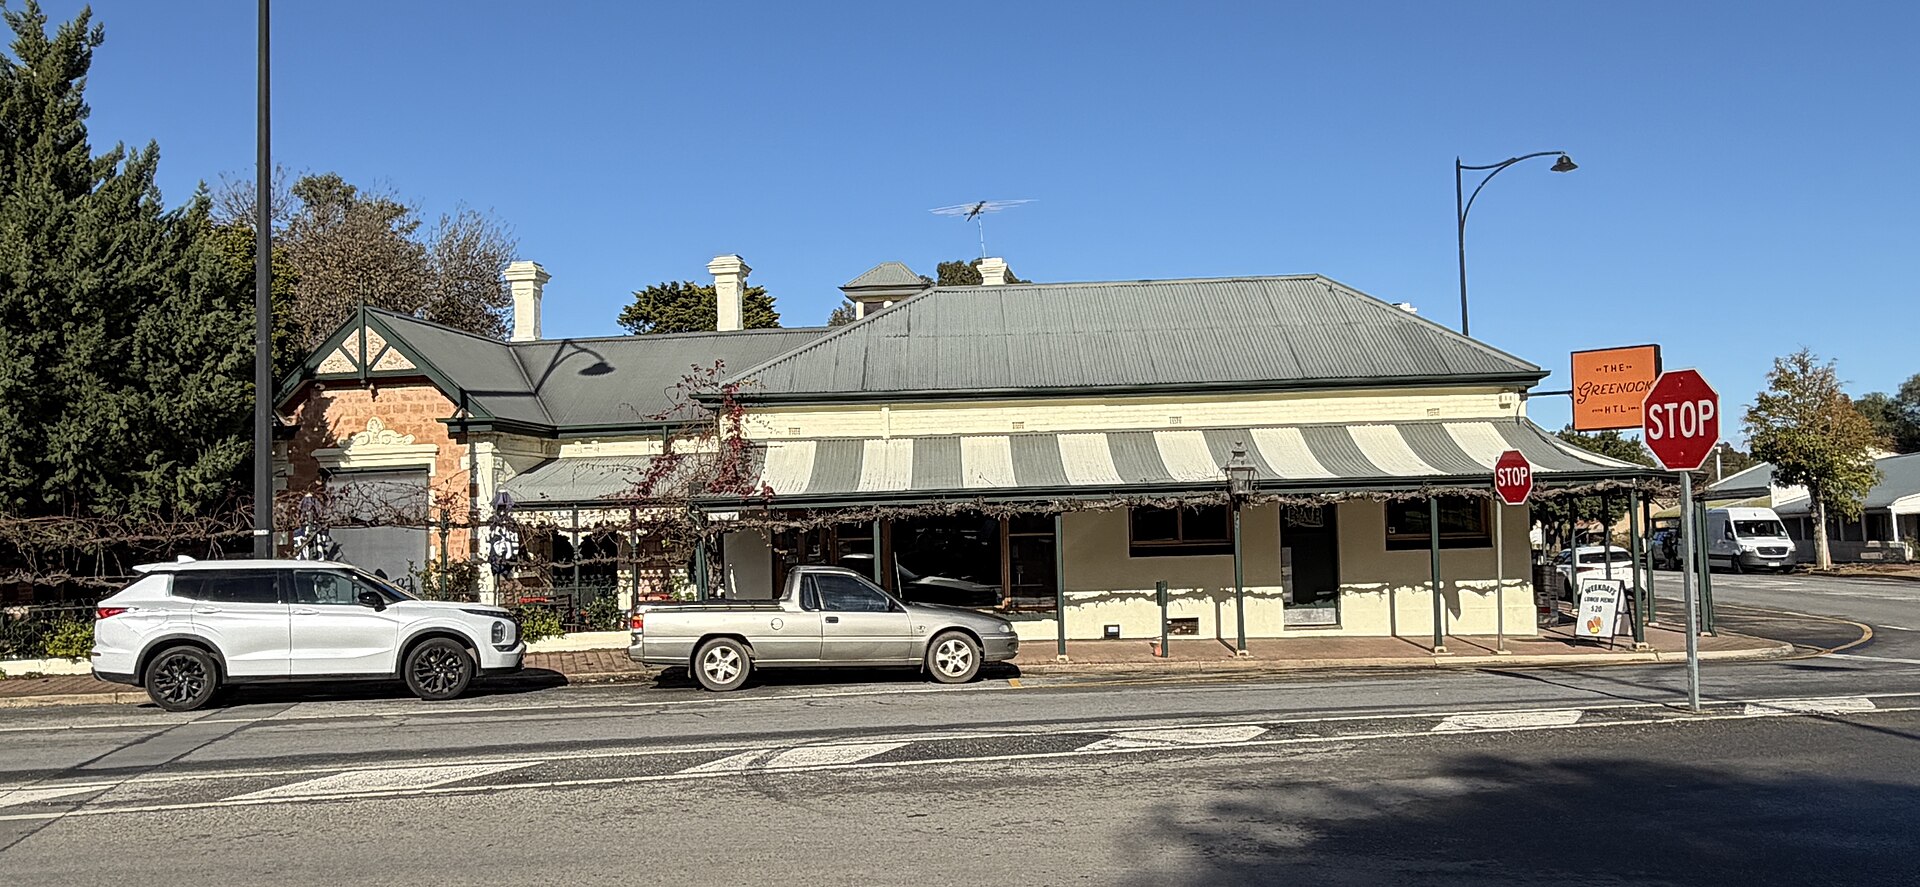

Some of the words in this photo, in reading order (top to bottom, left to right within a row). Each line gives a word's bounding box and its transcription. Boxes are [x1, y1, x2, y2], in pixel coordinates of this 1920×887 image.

[1603, 363, 1625, 373] THE
[1604, 405, 1626, 414] HTL
[1648, 399, 1715, 440] STOP
[1498, 466, 1528, 487] STOP
[1585, 584, 1616, 595] WEEKDAYS
